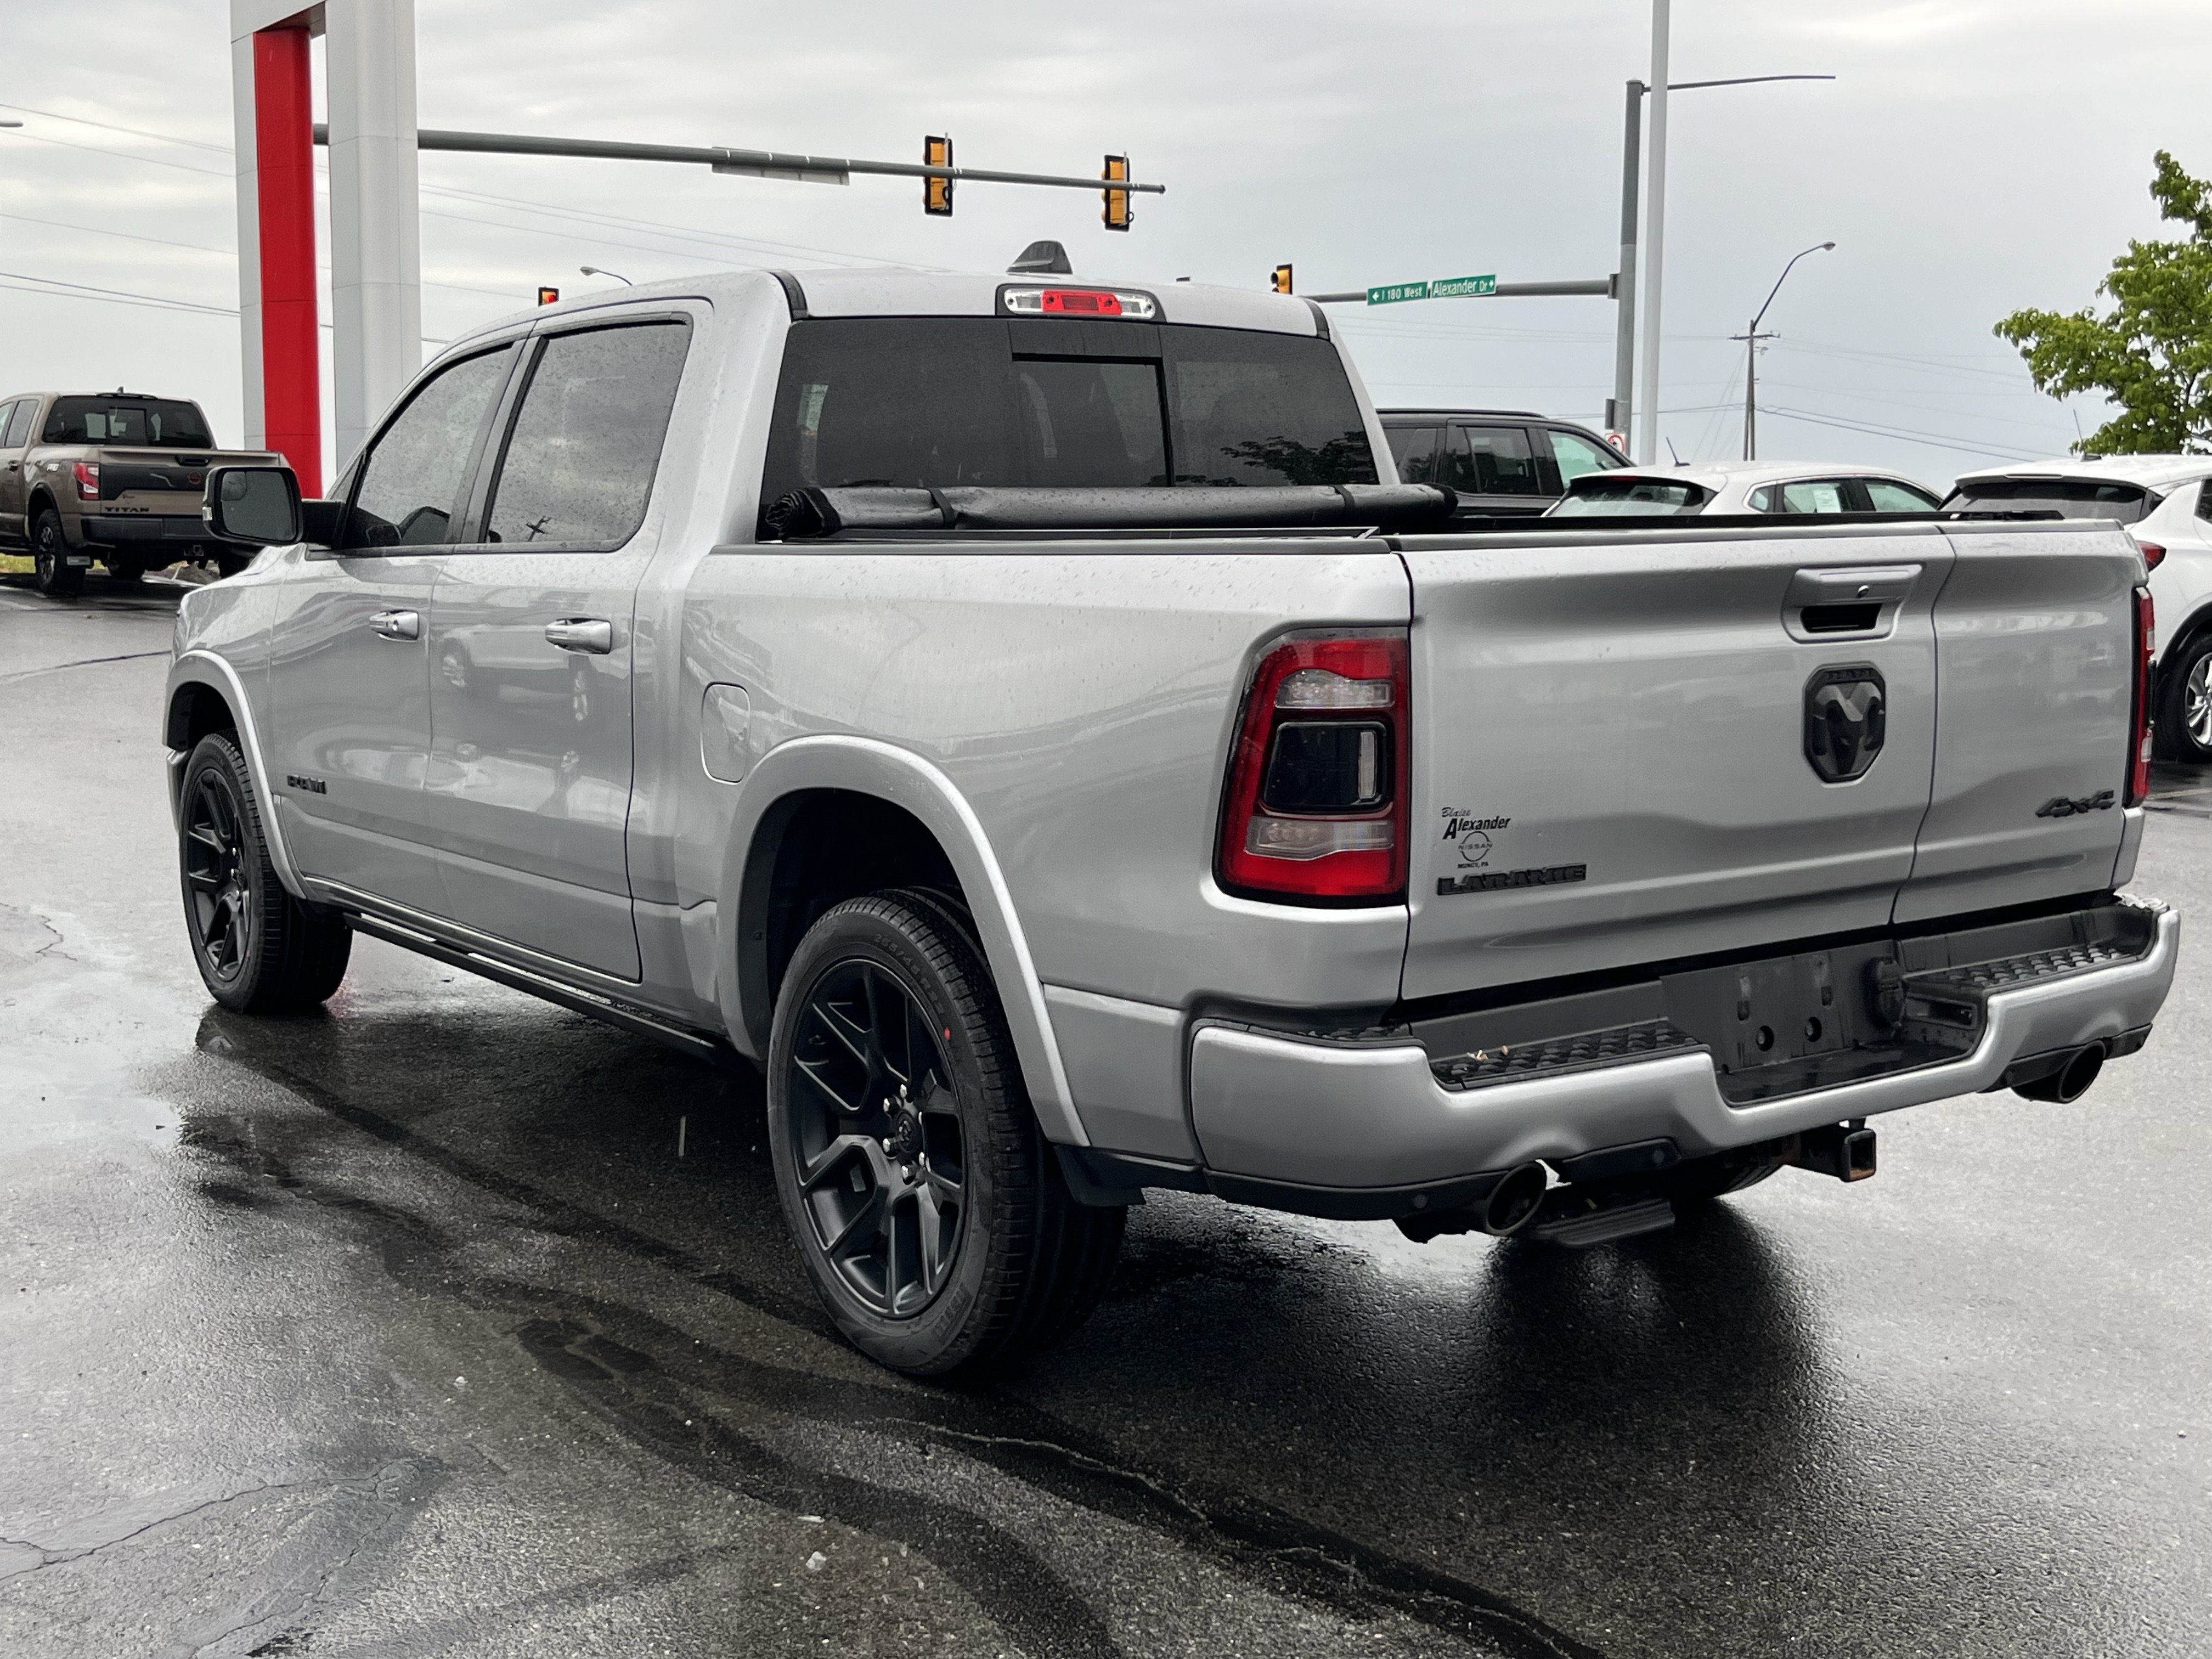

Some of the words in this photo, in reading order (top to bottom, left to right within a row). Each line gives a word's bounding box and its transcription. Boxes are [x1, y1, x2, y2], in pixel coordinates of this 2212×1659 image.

[1387, 288, 1401, 301] 180
[1404, 286, 1422, 298] West
[1433, 280, 1477, 296] Alexander
[1479, 280, 1487, 291] Dr
[287, 775, 326, 794] RAM
[1442, 815, 1511, 840] Alexander
[1437, 864, 1587, 896] LARAMIE
